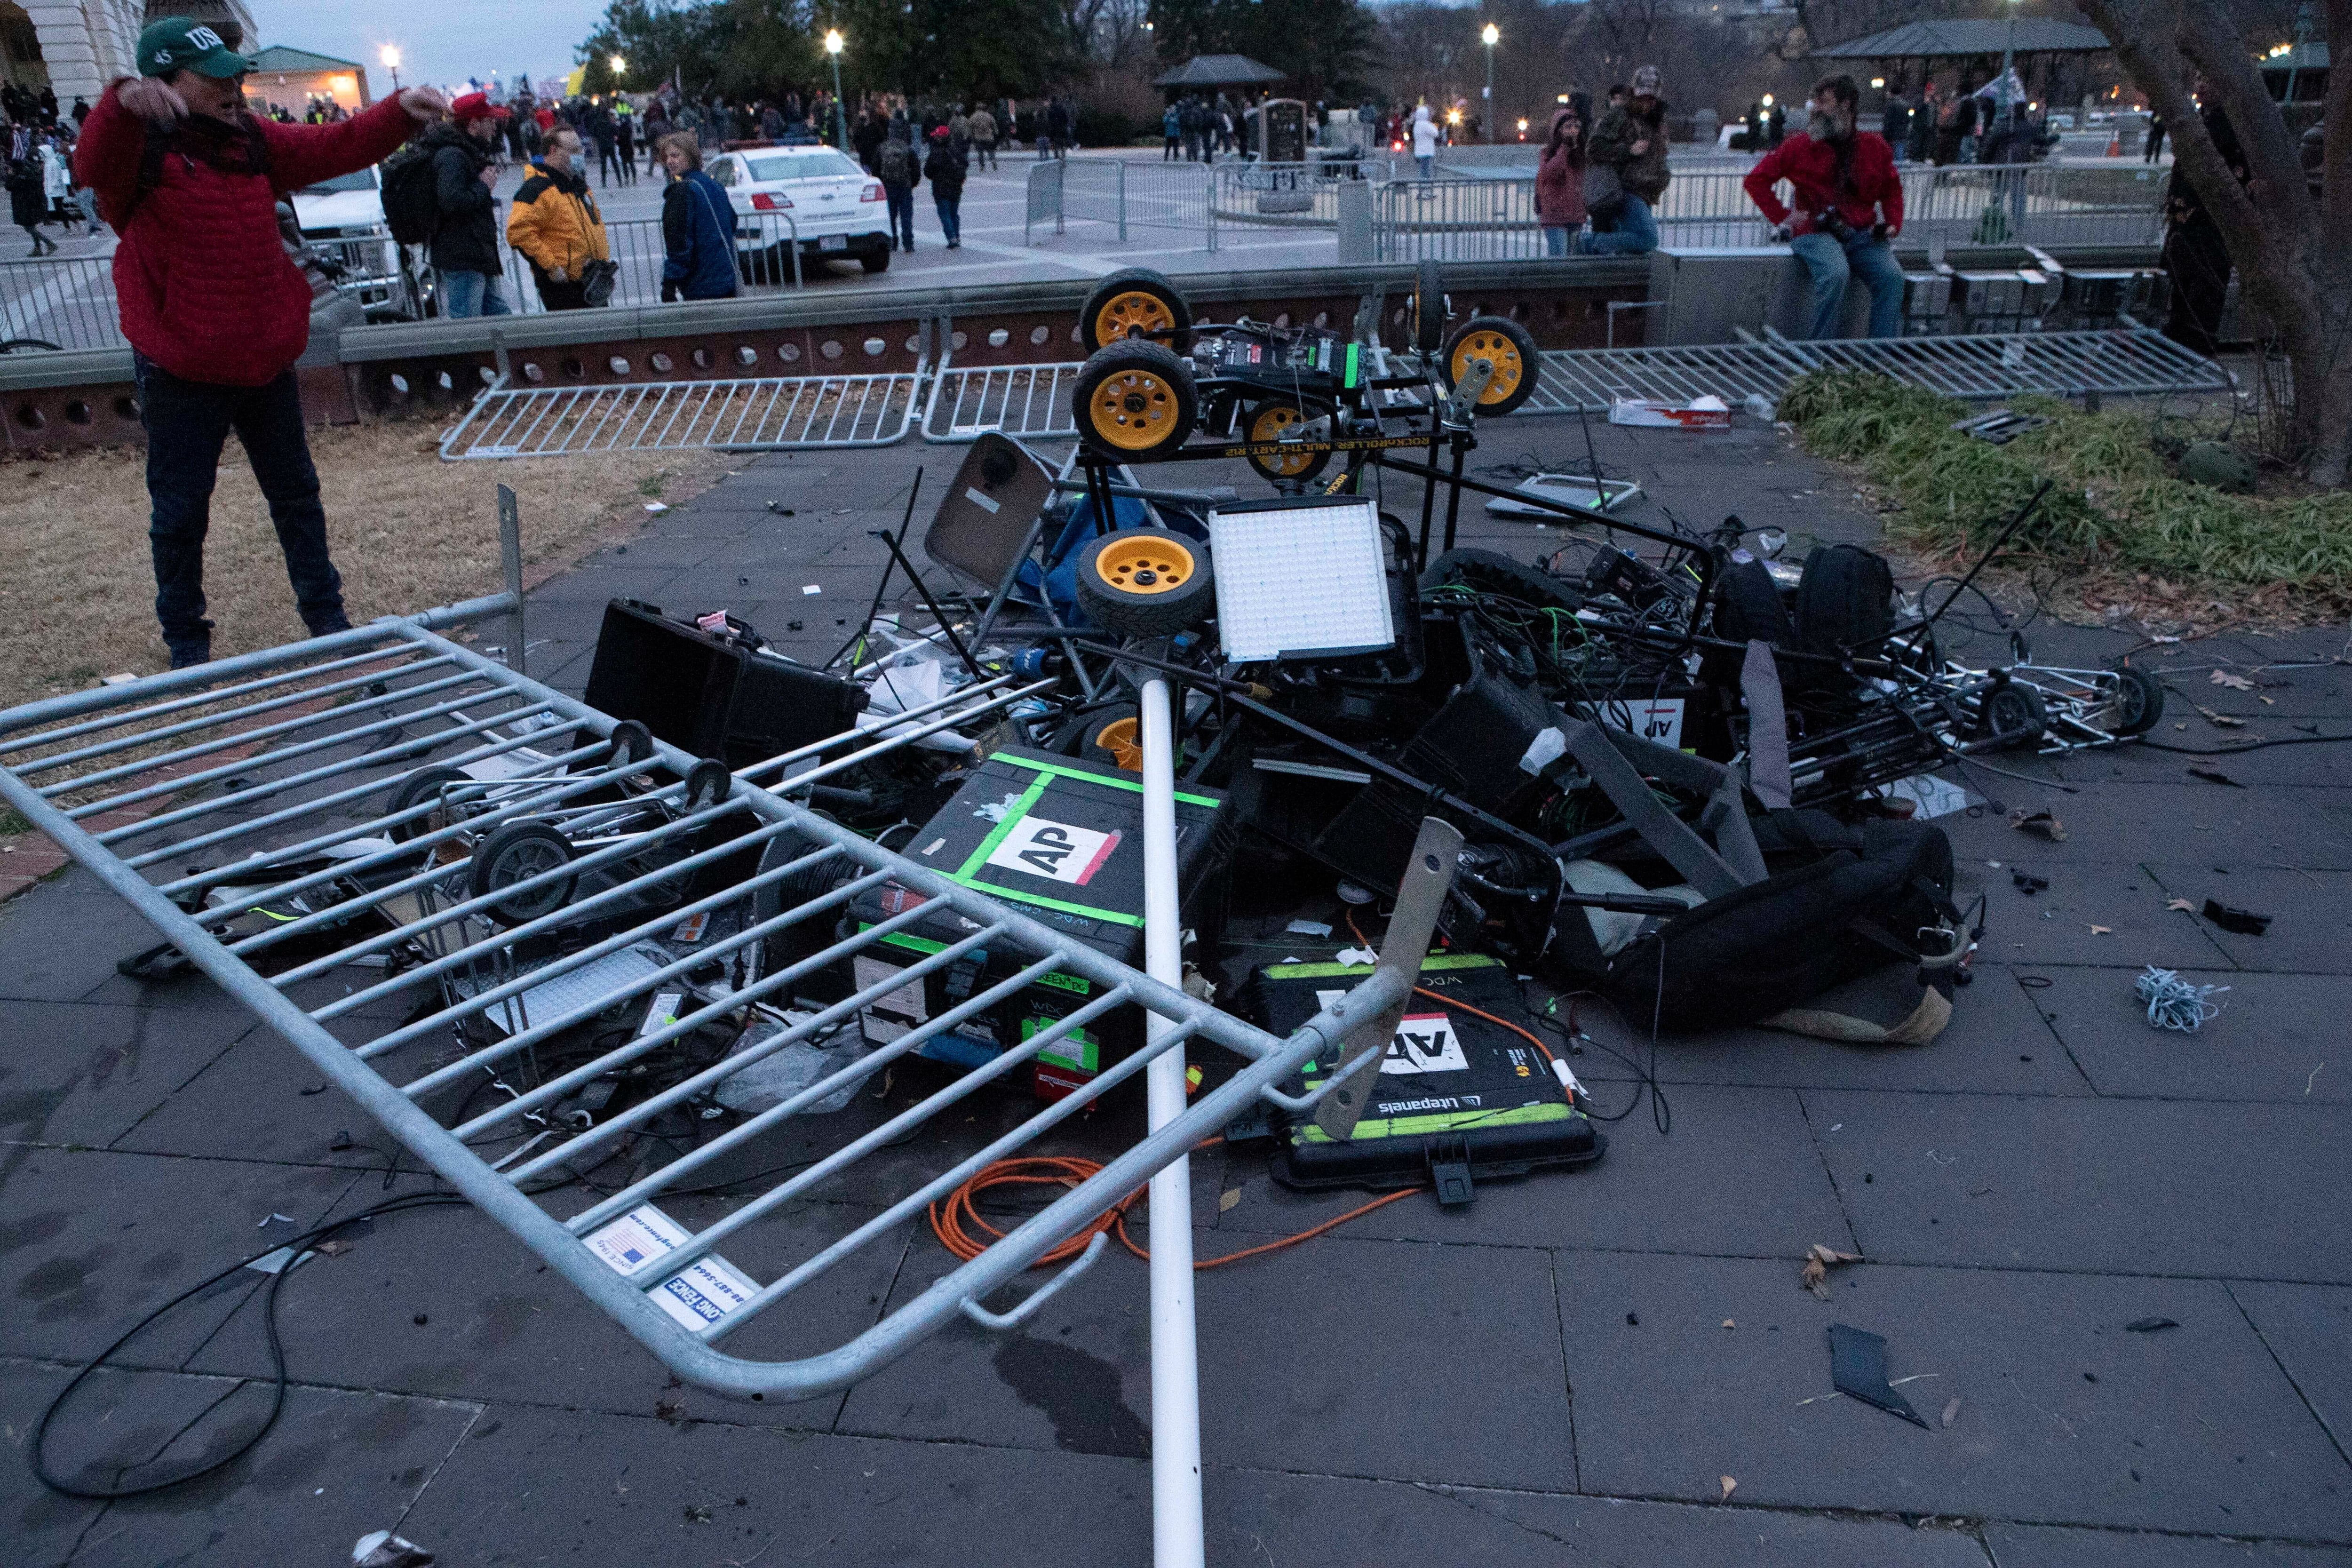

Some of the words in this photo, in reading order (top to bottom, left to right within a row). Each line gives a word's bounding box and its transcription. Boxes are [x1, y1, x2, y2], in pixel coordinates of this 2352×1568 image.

[154, 49, 173, 64] 45
[1324, 473, 1348, 495] ROCKn
[1645, 721, 1672, 737] AP
[1018, 826, 1076, 875] AP
[1423, 976, 1462, 986] WDC
[1378, 1098, 1459, 1114] Litepanels
[628, 1214, 676, 1250] ongfence.com
[596, 1239, 610, 1256] 1945
[610, 1254, 633, 1270] SINCE
[668, 1277, 697, 1307] FENCE
[693, 1265, 745, 1304] 88-887-5664
[696, 1297, 726, 1323] ONG
